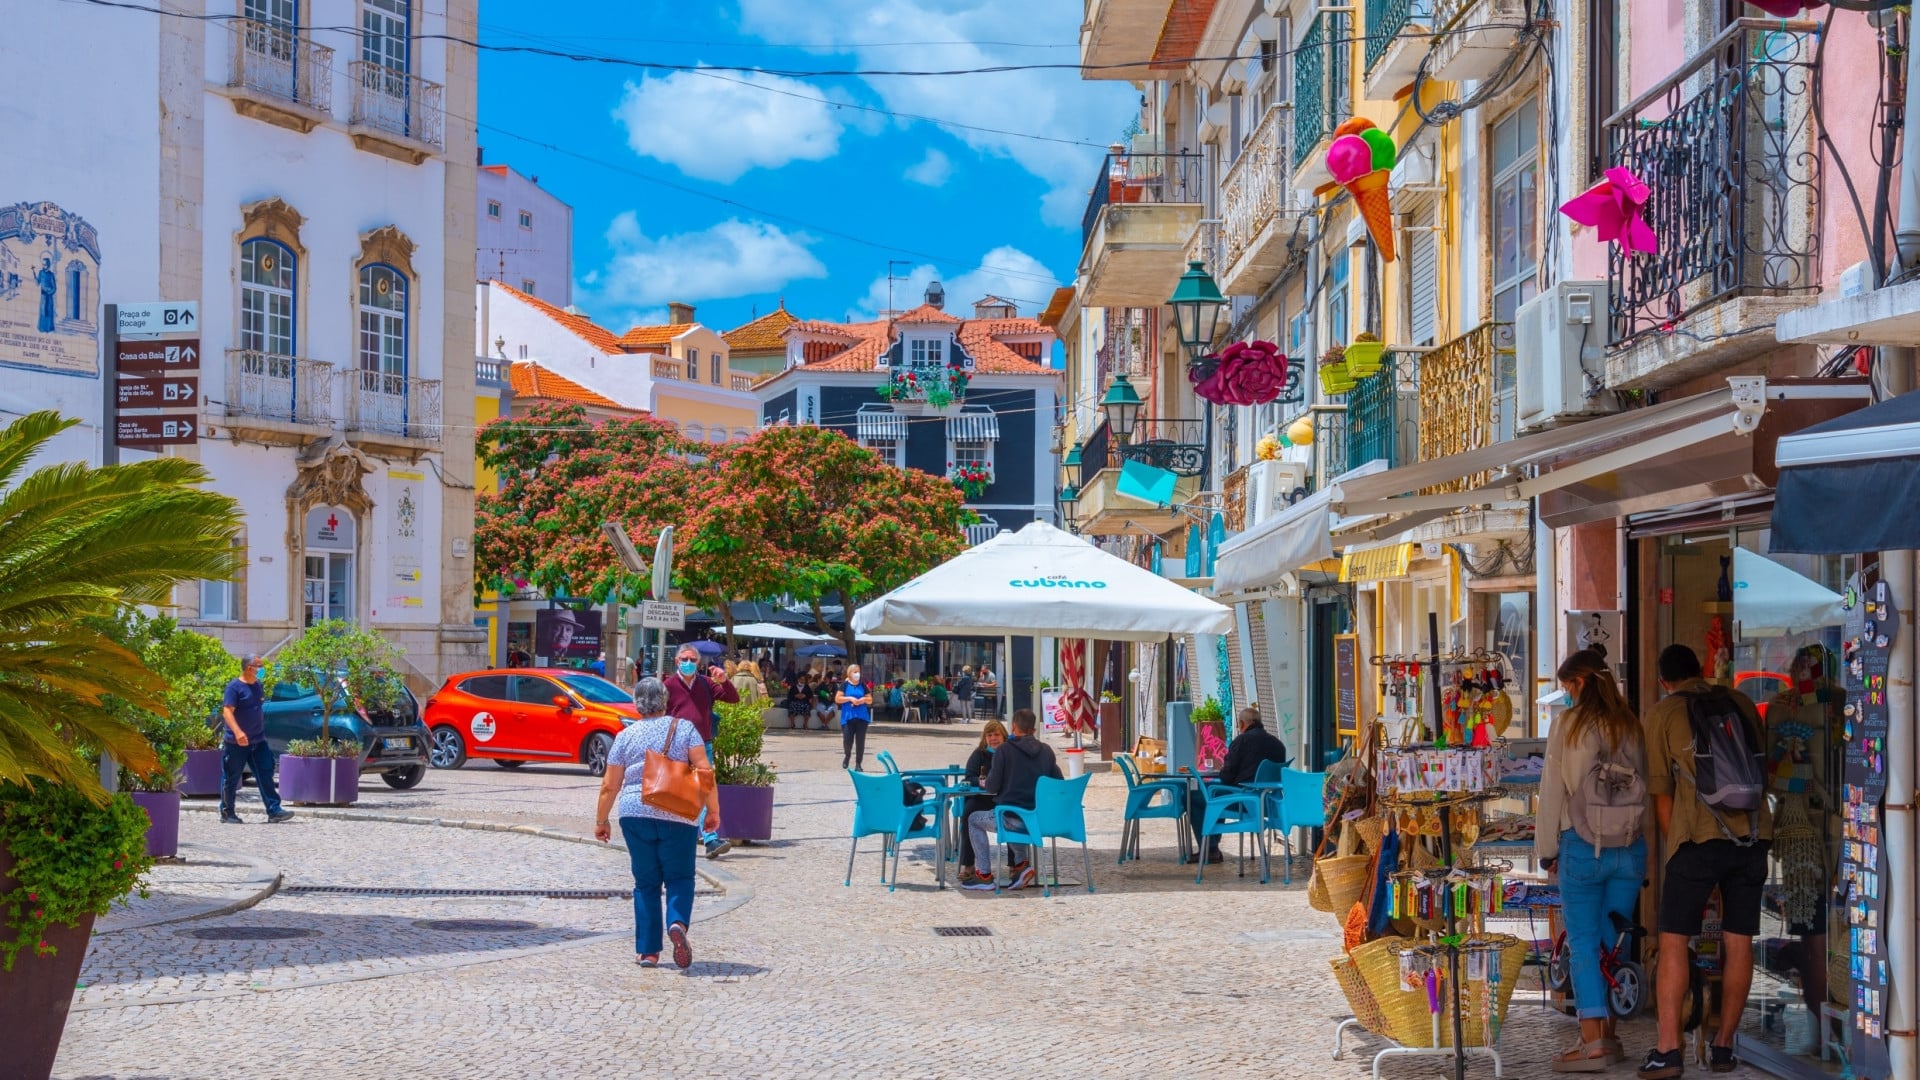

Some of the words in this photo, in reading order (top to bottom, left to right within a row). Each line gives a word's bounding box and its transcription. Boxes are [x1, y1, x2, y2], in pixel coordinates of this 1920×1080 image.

[119, 311, 140, 319] Praça
[119, 320, 146, 328] Bocage
[119, 352, 138, 360] Casa
[1009, 578, 1106, 588] cubano
